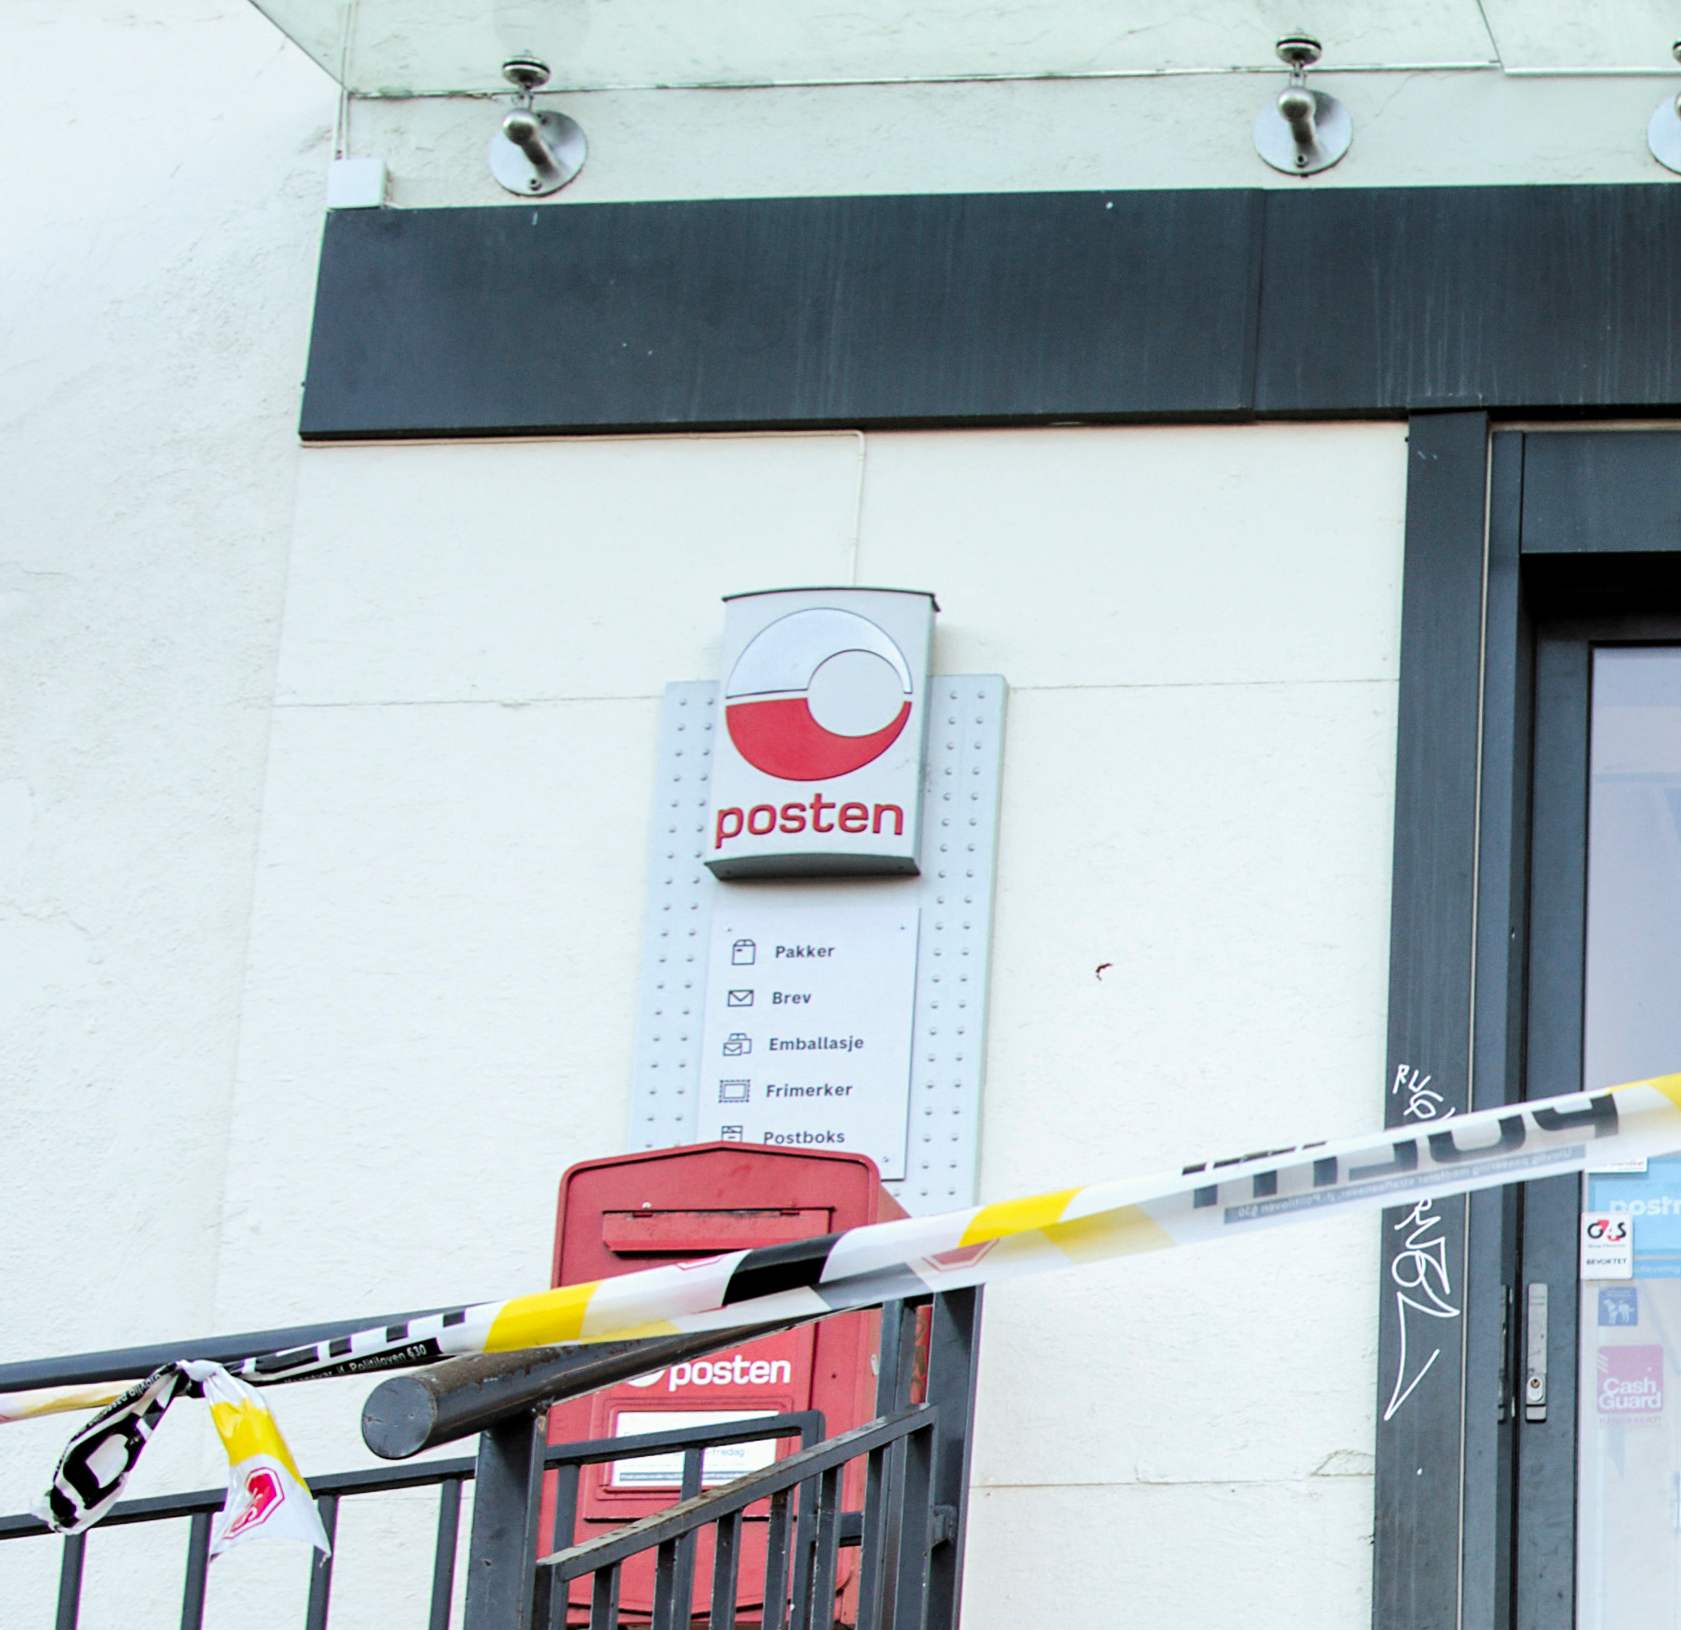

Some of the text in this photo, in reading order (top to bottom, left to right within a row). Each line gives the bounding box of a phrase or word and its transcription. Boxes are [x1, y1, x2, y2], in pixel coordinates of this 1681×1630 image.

[714, 793, 904, 848] posten
[775, 943, 835, 959] Pakker
[772, 990, 811, 1005] Brev
[769, 1036, 864, 1053] Emballasje
[766, 1082, 853, 1099] Frimerker
[763, 1129, 846, 1146] Postboks
[668, 1354, 792, 1391] posten
[1603, 1377, 1657, 1394] Cash
[1599, 1392, 1662, 1409] Guard
